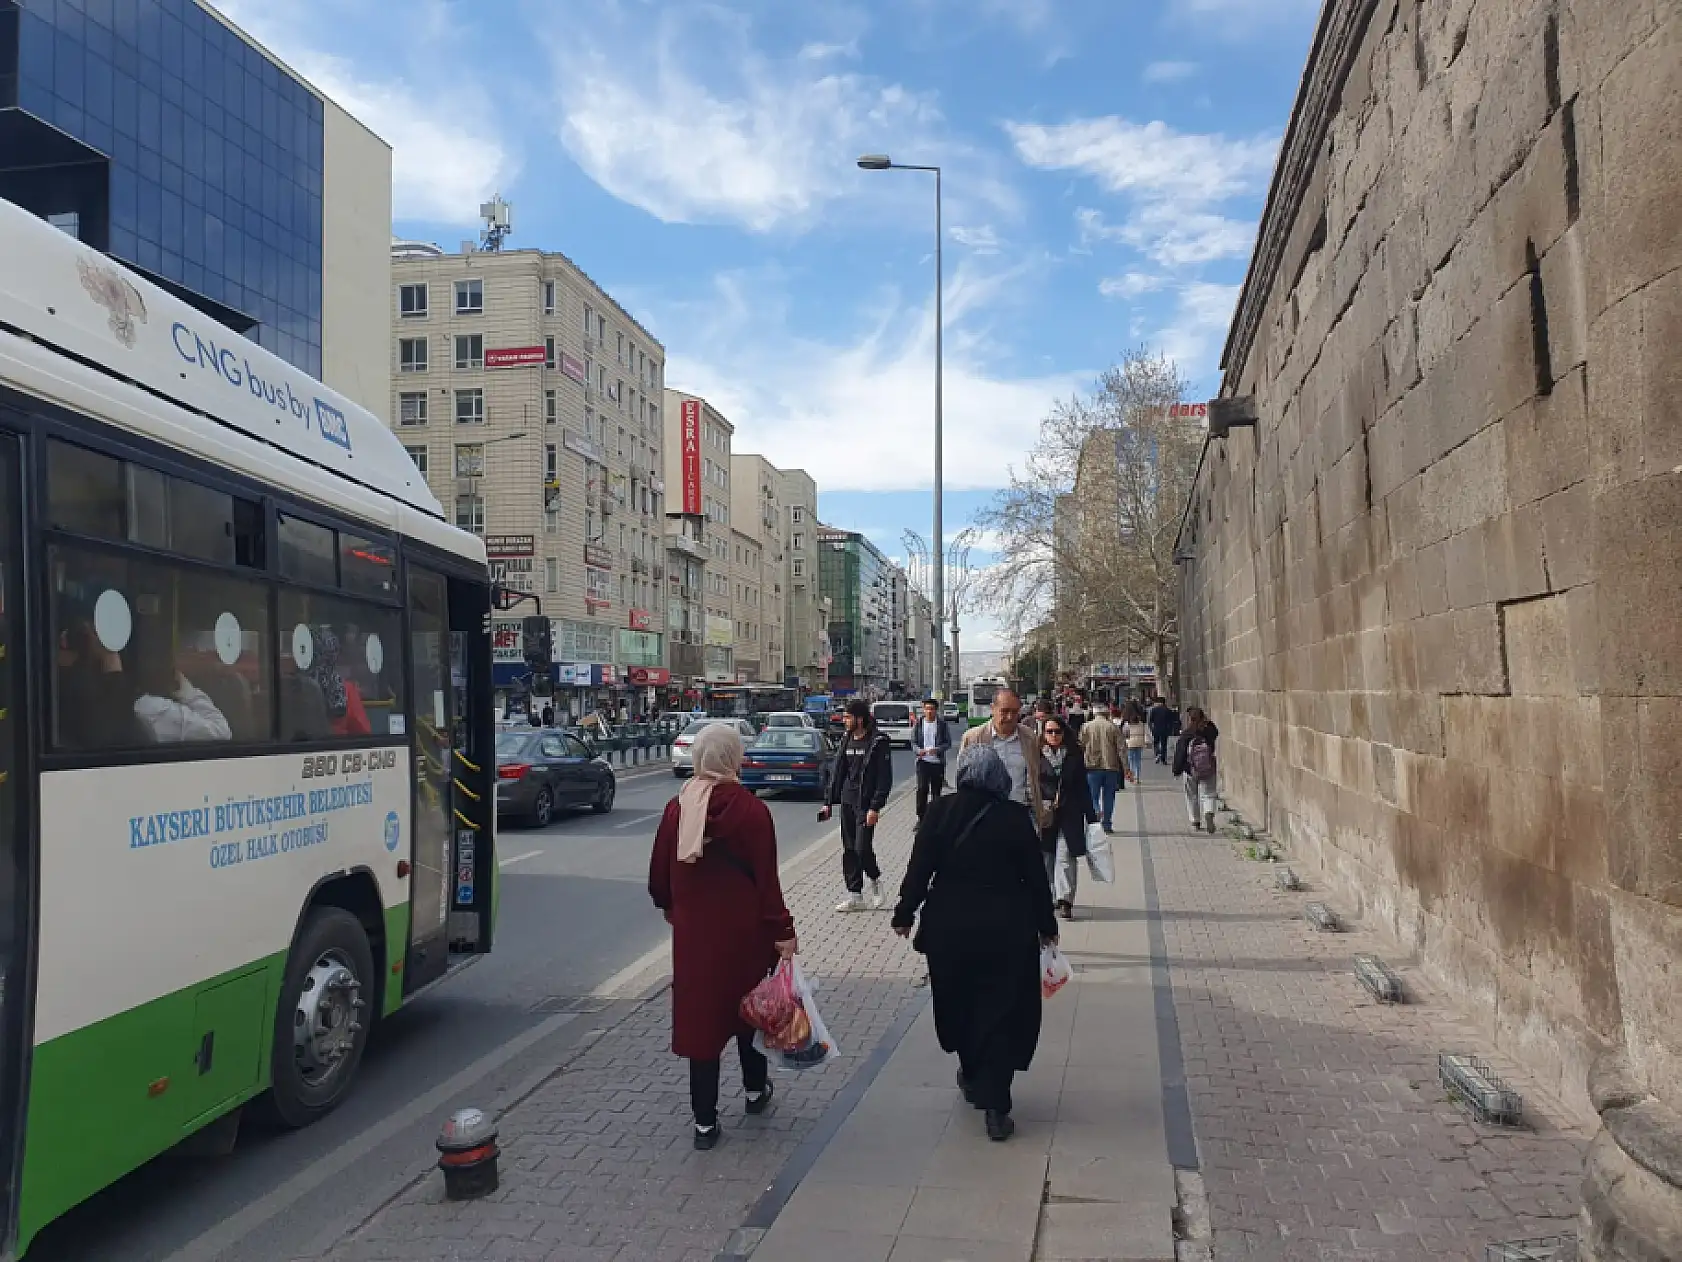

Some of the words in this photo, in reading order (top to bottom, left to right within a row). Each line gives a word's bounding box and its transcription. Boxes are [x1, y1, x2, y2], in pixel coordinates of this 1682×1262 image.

[172, 321, 242, 387] CNG
[244, 358, 286, 411] bus
[284, 380, 310, 431] by
[685, 402, 695, 452] ESRA
[129, 795, 210, 848] KAYSERİ
[214, 784, 306, 832] BÜYÜKŞEHİR
[209, 840, 243, 868] ÖZEL
[246, 833, 278, 860] HALK
